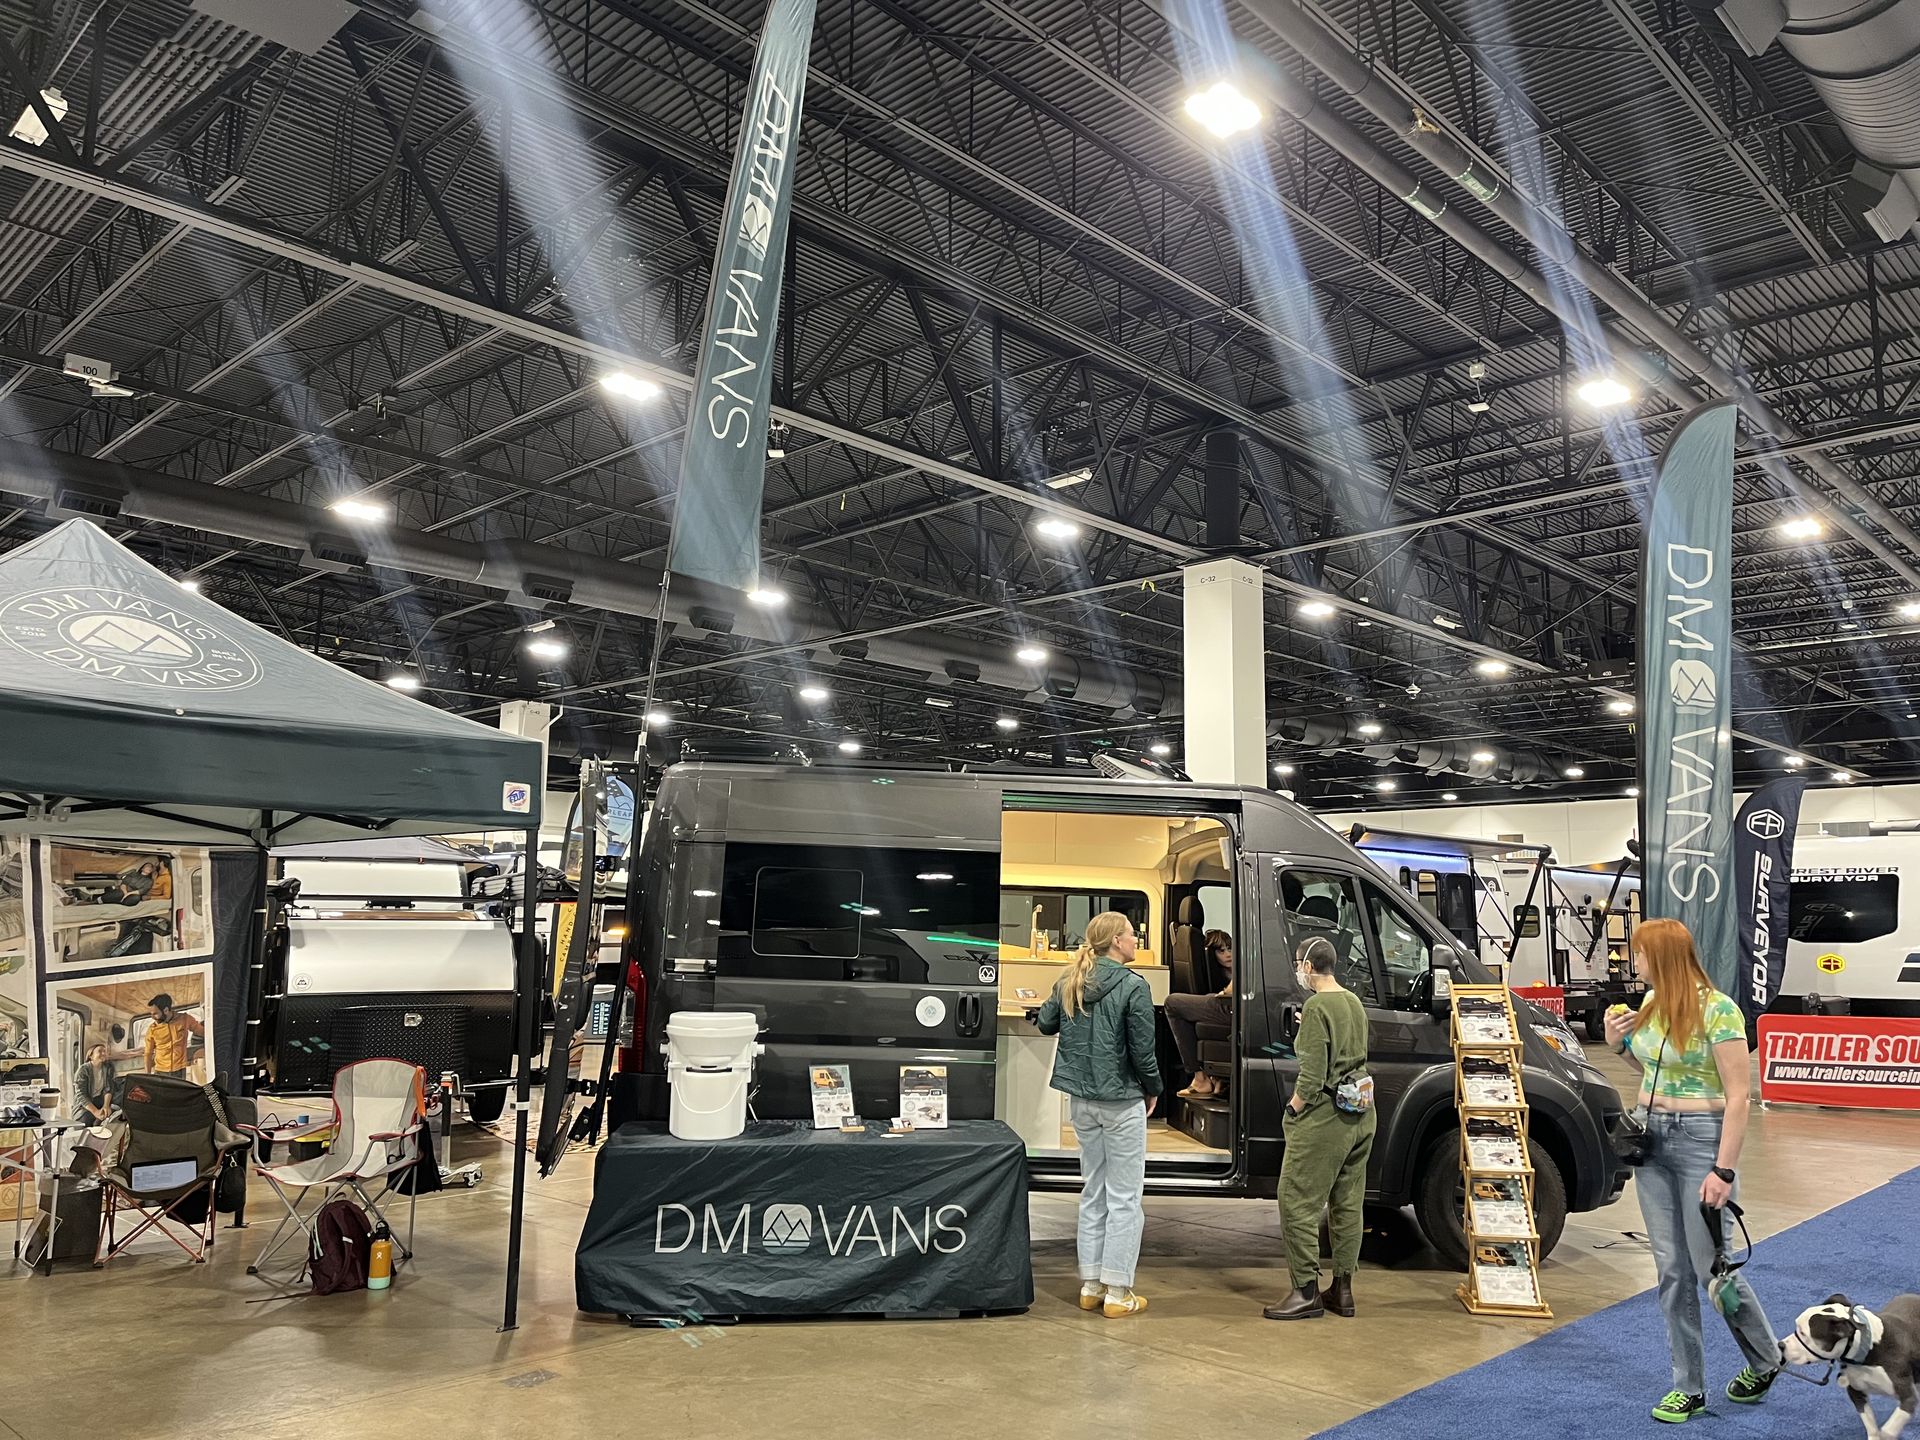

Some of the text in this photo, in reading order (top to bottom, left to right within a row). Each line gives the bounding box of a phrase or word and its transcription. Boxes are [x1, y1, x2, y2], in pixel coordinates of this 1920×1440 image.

[708, 70, 790, 449] DM VANS
[82, 365, 98, 376] 100
[1200, 575, 1216, 584] C-32
[18, 592, 217, 641] DM VANS
[43, 647, 243, 686] DM VANS
[1666, 543, 1721, 904] DM VANS
[1791, 867, 1840, 875] REST
[1751, 852, 1774, 1006] SURVEYOR
[1769, 1035, 1870, 1062] TRAILER
[654, 1203, 969, 1257] DM VANS
